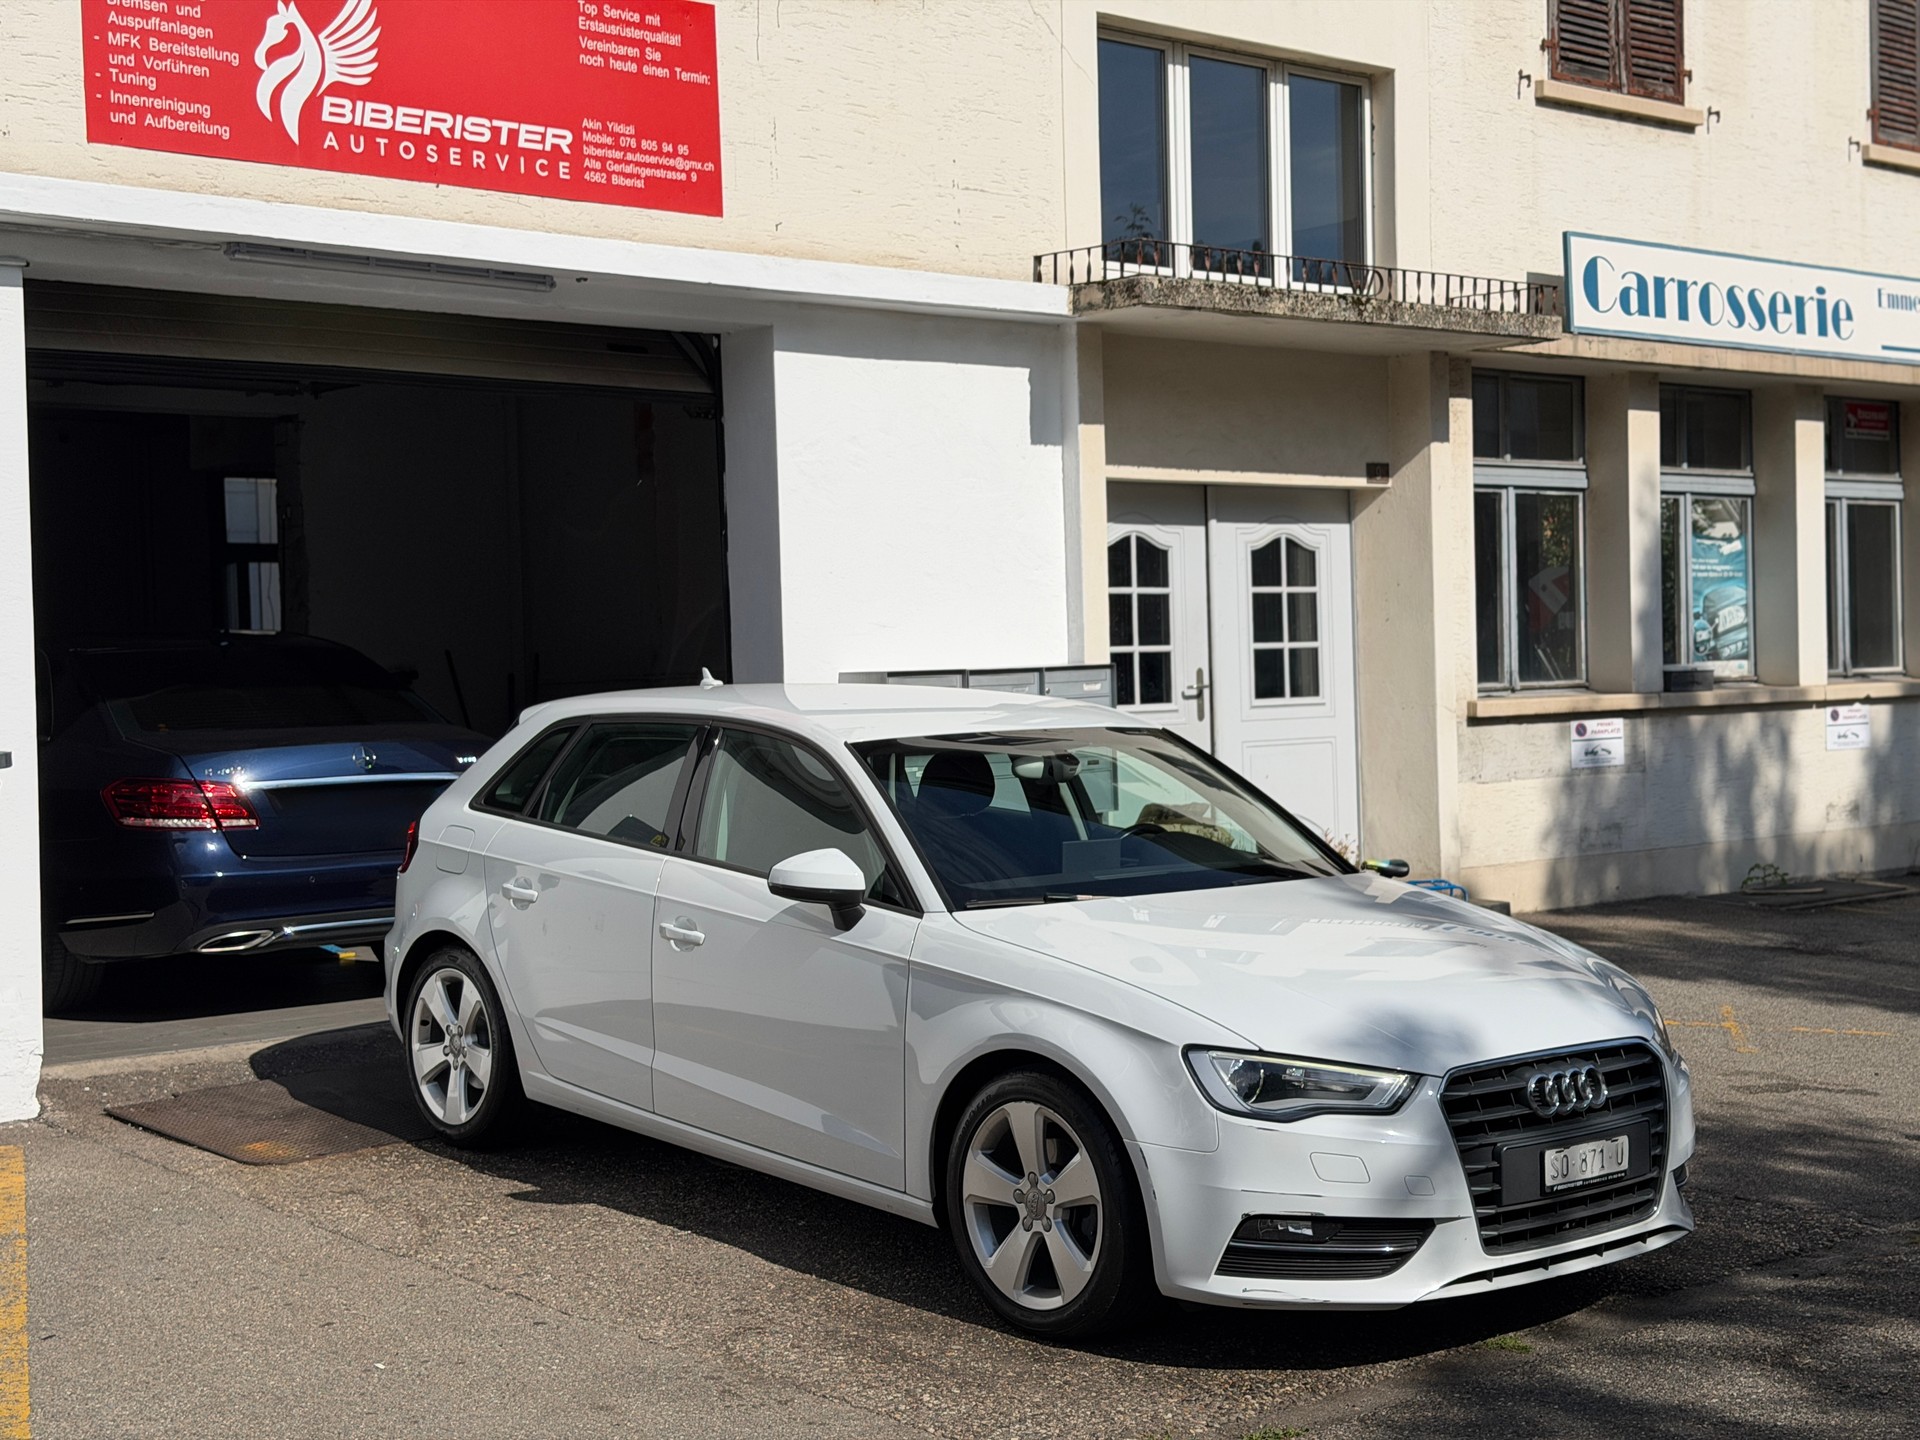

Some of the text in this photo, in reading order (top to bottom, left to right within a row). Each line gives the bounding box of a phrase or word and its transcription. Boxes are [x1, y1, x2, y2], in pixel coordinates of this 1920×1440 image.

[108, 11, 214, 39] Auspuffanlagen
[176, 5, 201, 18] und
[578, 1, 661, 27] Top Service mit
[578, 17, 682, 47] Erstausrüsterqualität!
[108, 32, 141, 49] MFK
[149, 38, 240, 66] Bereitstellung
[579, 36, 662, 62] Vereinbaren Sie
[108, 53, 210, 78] und Vorführen
[109, 68, 157, 90] Tuning
[579, 53, 711, 85] noch heute einen Termin:
[110, 90, 211, 118] Innenreinigung
[110, 111, 230, 139] und Aufbereitung
[321, 95, 573, 154] BIBERISTER
[582, 118, 602, 130] Akin
[323, 131, 571, 179] AUTOSERVICE
[583, 132, 689, 155] Mobile: 076 805 94 95
[583, 145, 715, 172] biberister.autoservice@gmx.ch
[583, 158, 698, 182] Alte Gerlafingenstrasse 9
[611, 174, 645, 189] Biberist
[1583, 255, 1855, 341] Carrosserie
[1550, 1141, 1624, 1181] SO 871 U
